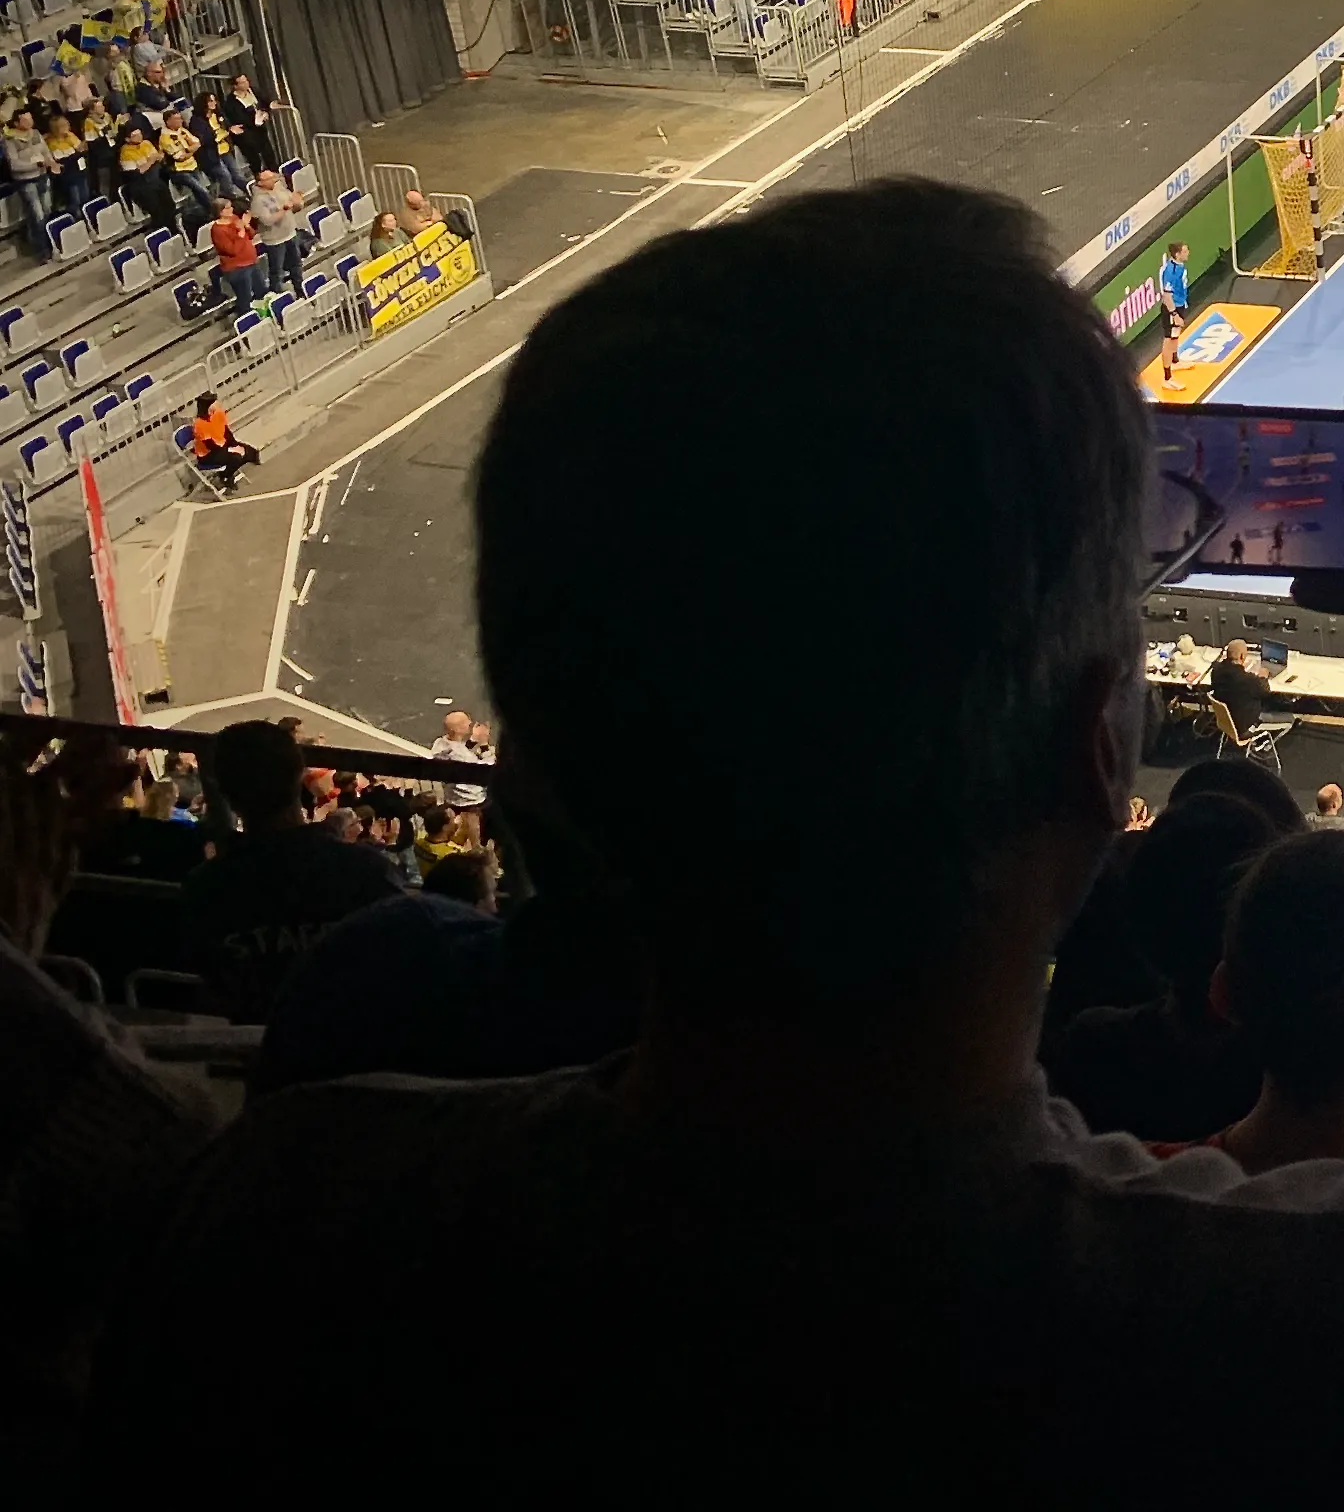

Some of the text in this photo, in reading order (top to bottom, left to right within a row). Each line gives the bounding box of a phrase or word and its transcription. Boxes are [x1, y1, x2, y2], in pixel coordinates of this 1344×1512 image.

[1269, 80, 1290, 110] DKB
[1166, 168, 1191, 201] DKB
[1104, 216, 1131, 251] DKB
